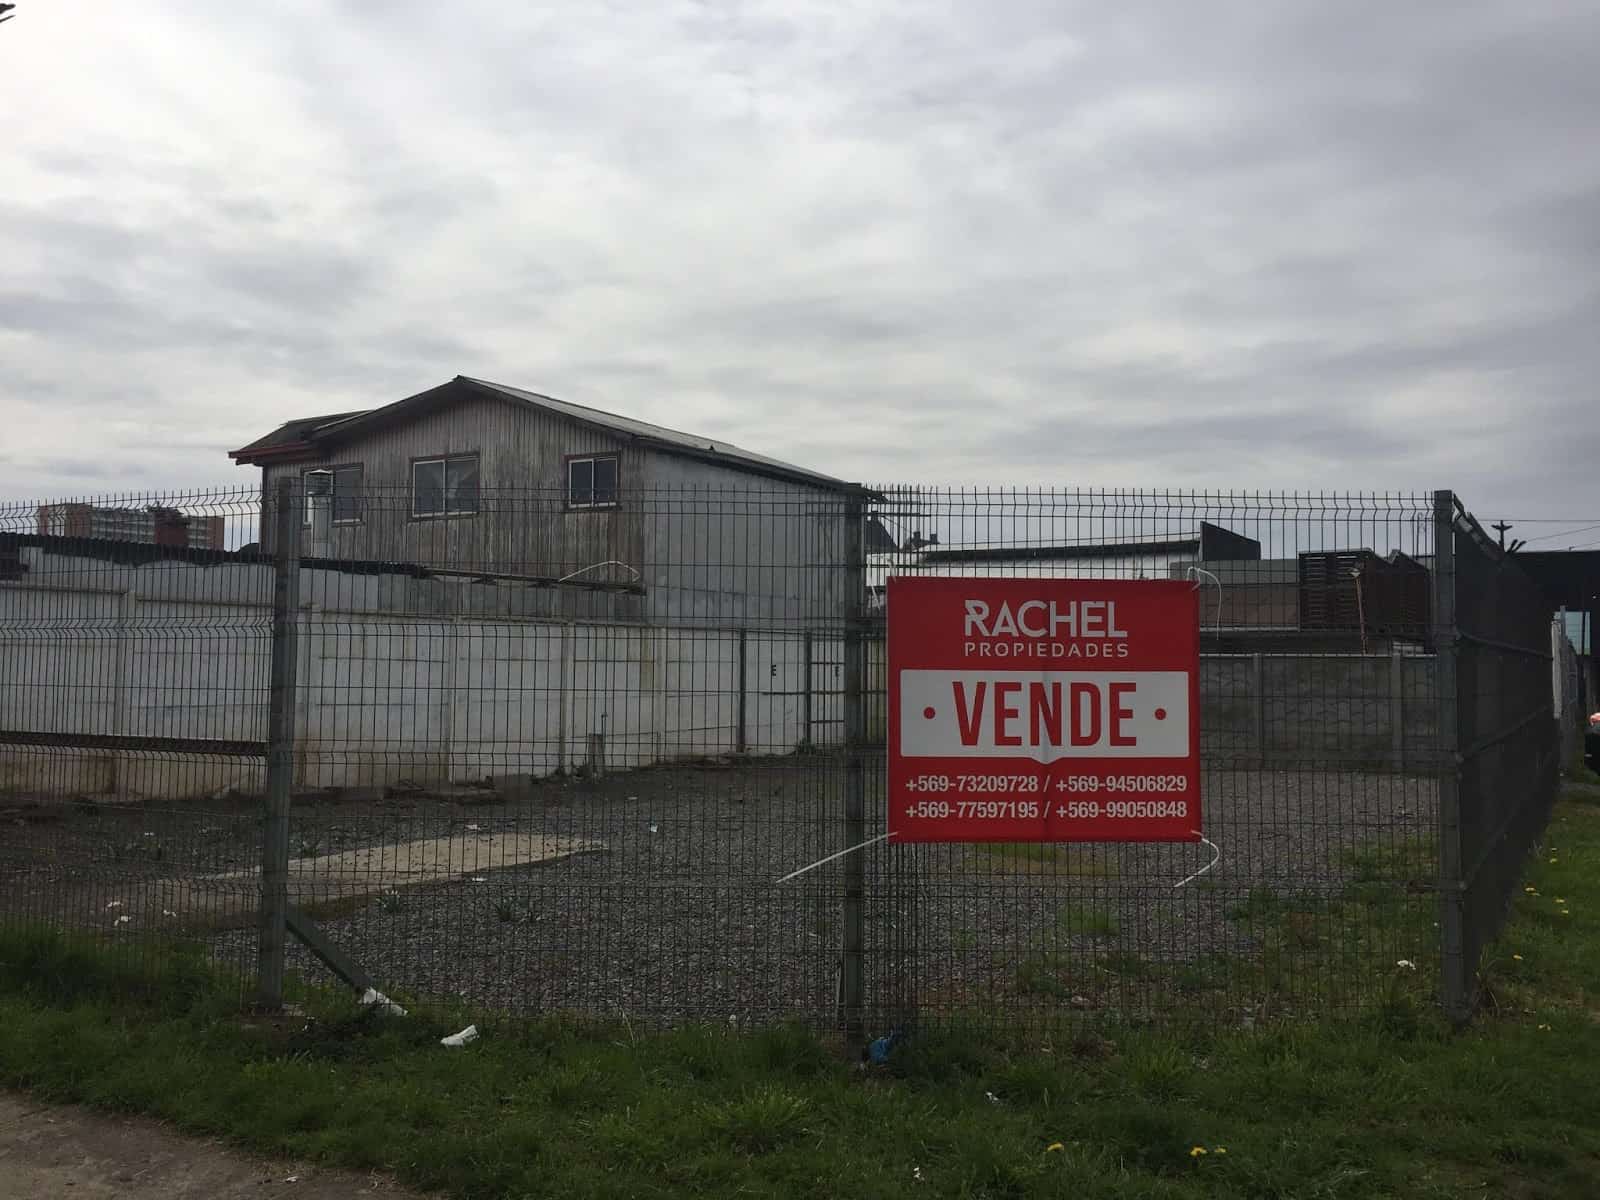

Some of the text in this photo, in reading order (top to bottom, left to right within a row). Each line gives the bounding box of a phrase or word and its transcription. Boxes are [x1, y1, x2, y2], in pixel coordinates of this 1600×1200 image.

[964, 599, 1128, 638] RACHEL
[964, 641, 1129, 658] PROPIEDADES
[951, 681, 1137, 747] VENDE
[905, 775, 1039, 793] +569-73209728
[1055, 775, 1188, 793] +569-94506829
[905, 801, 1039, 819] +569-77597195
[1055, 801, 1188, 818] +569-99050848
